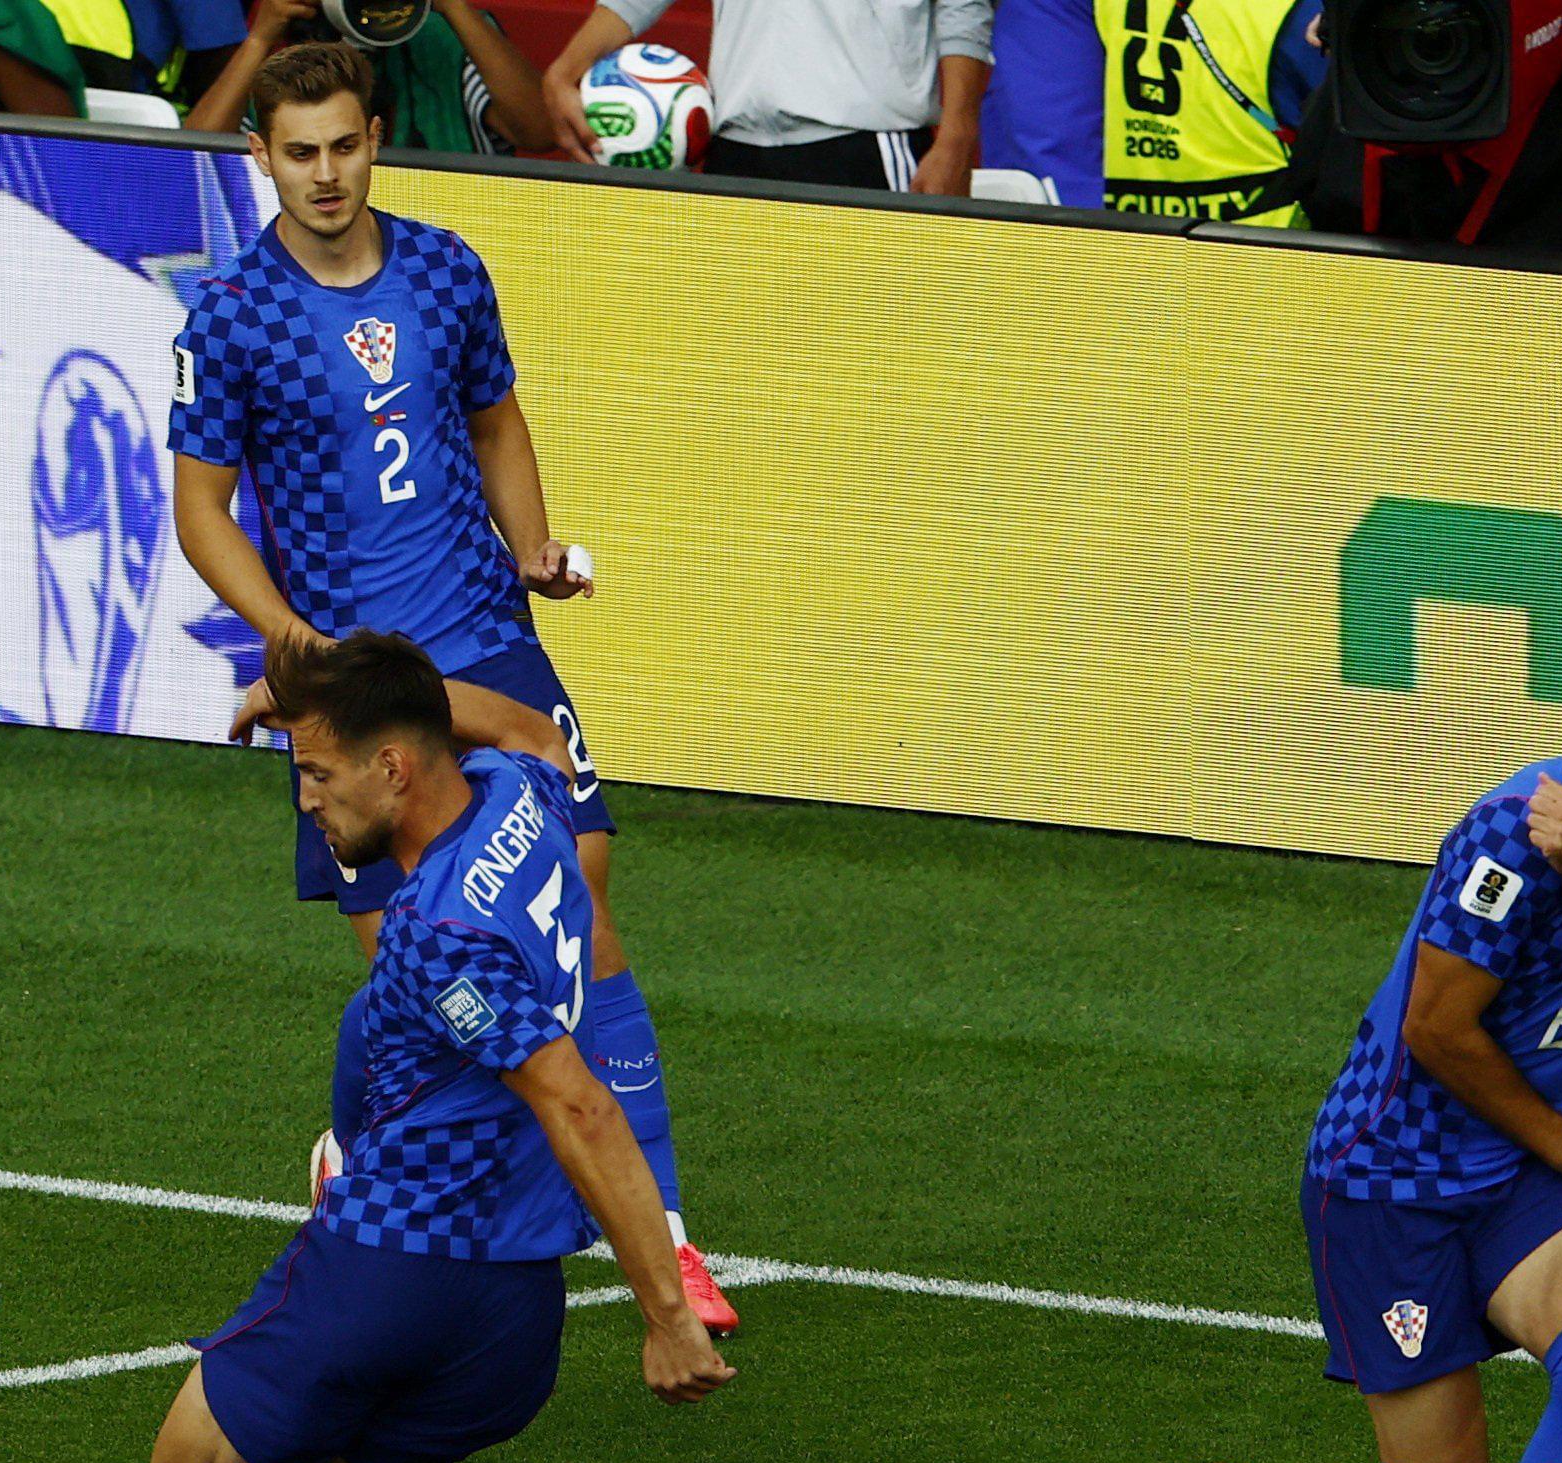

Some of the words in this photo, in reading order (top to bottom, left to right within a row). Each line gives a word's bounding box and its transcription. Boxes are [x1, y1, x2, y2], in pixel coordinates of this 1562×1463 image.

[1125, 136, 1181, 161] 2026
[1103, 186, 1264, 222] CURITY
[373, 427, 417, 505] 2
[552, 703, 595, 774] 2
[608, 1052, 655, 1070] HNS
